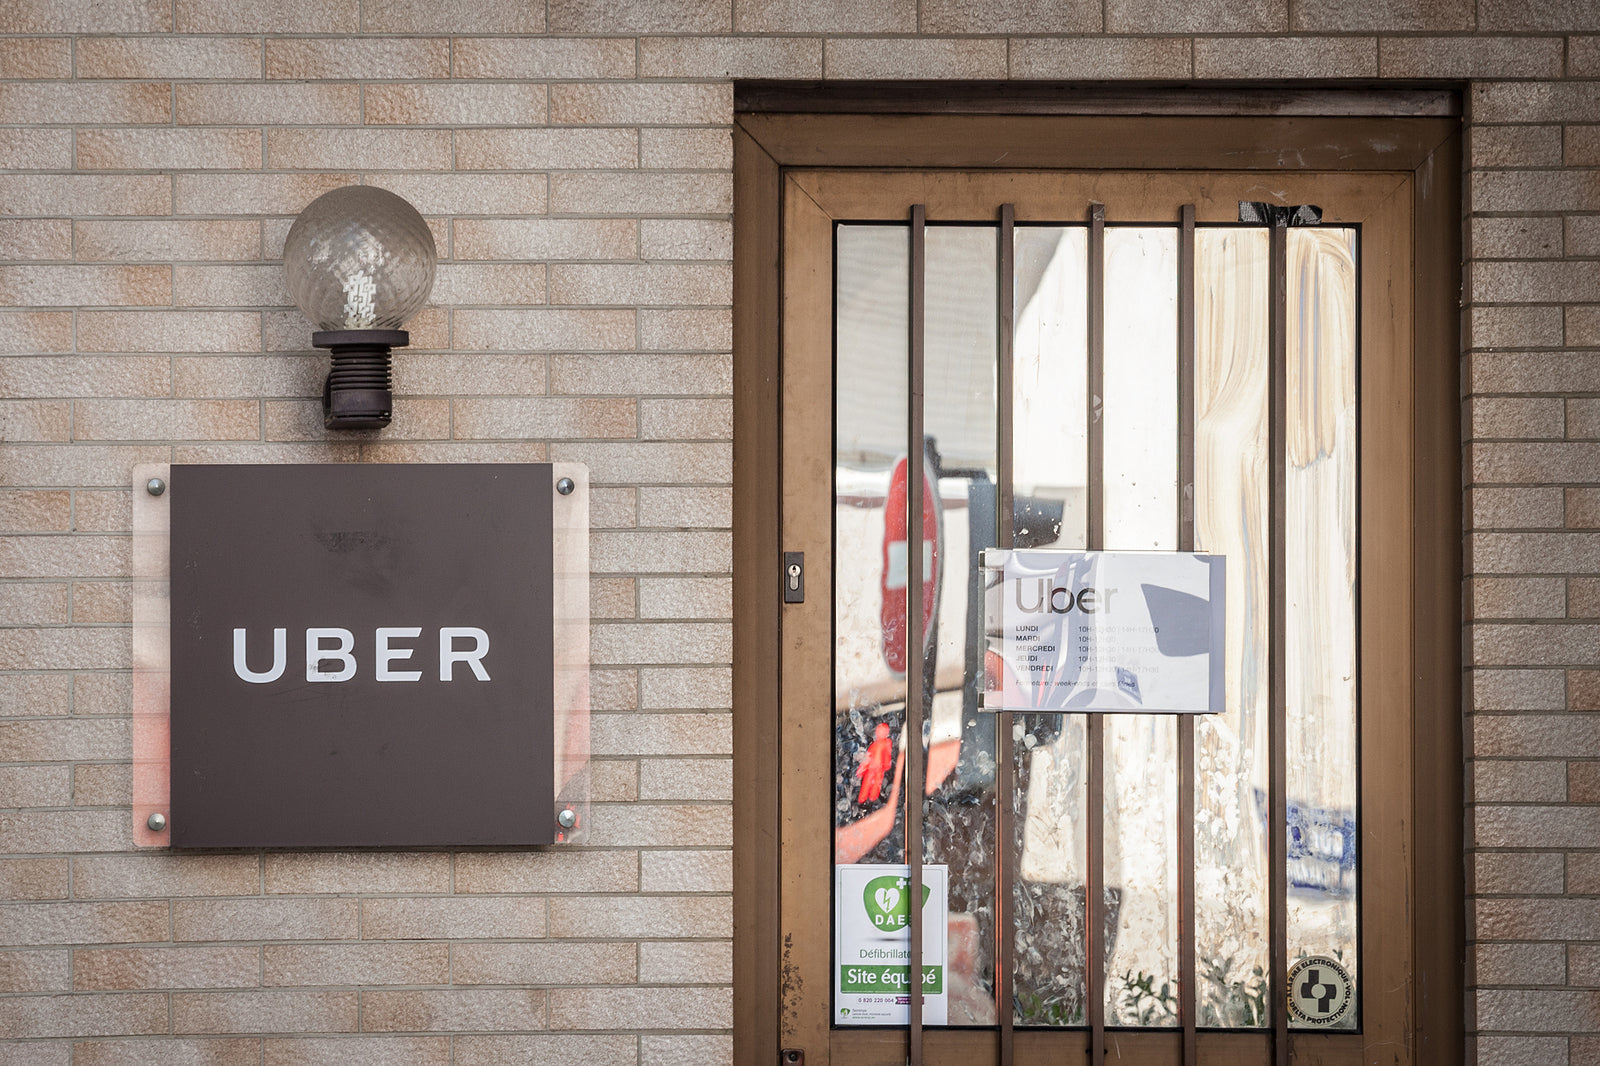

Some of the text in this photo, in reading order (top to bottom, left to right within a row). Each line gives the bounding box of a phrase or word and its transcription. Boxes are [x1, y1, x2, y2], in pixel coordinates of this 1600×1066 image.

[1015, 577, 1118, 615] Uber
[233, 627, 491, 684] UBER
[875, 914, 906, 926] DAE
[859, 948, 924, 959] Défibrillate
[847, 968, 936, 989] Site équé
[1301, 958, 1349, 983] ELECTRONIQUE
[1289, 1002, 1348, 1025] DELTA PROTECTION
